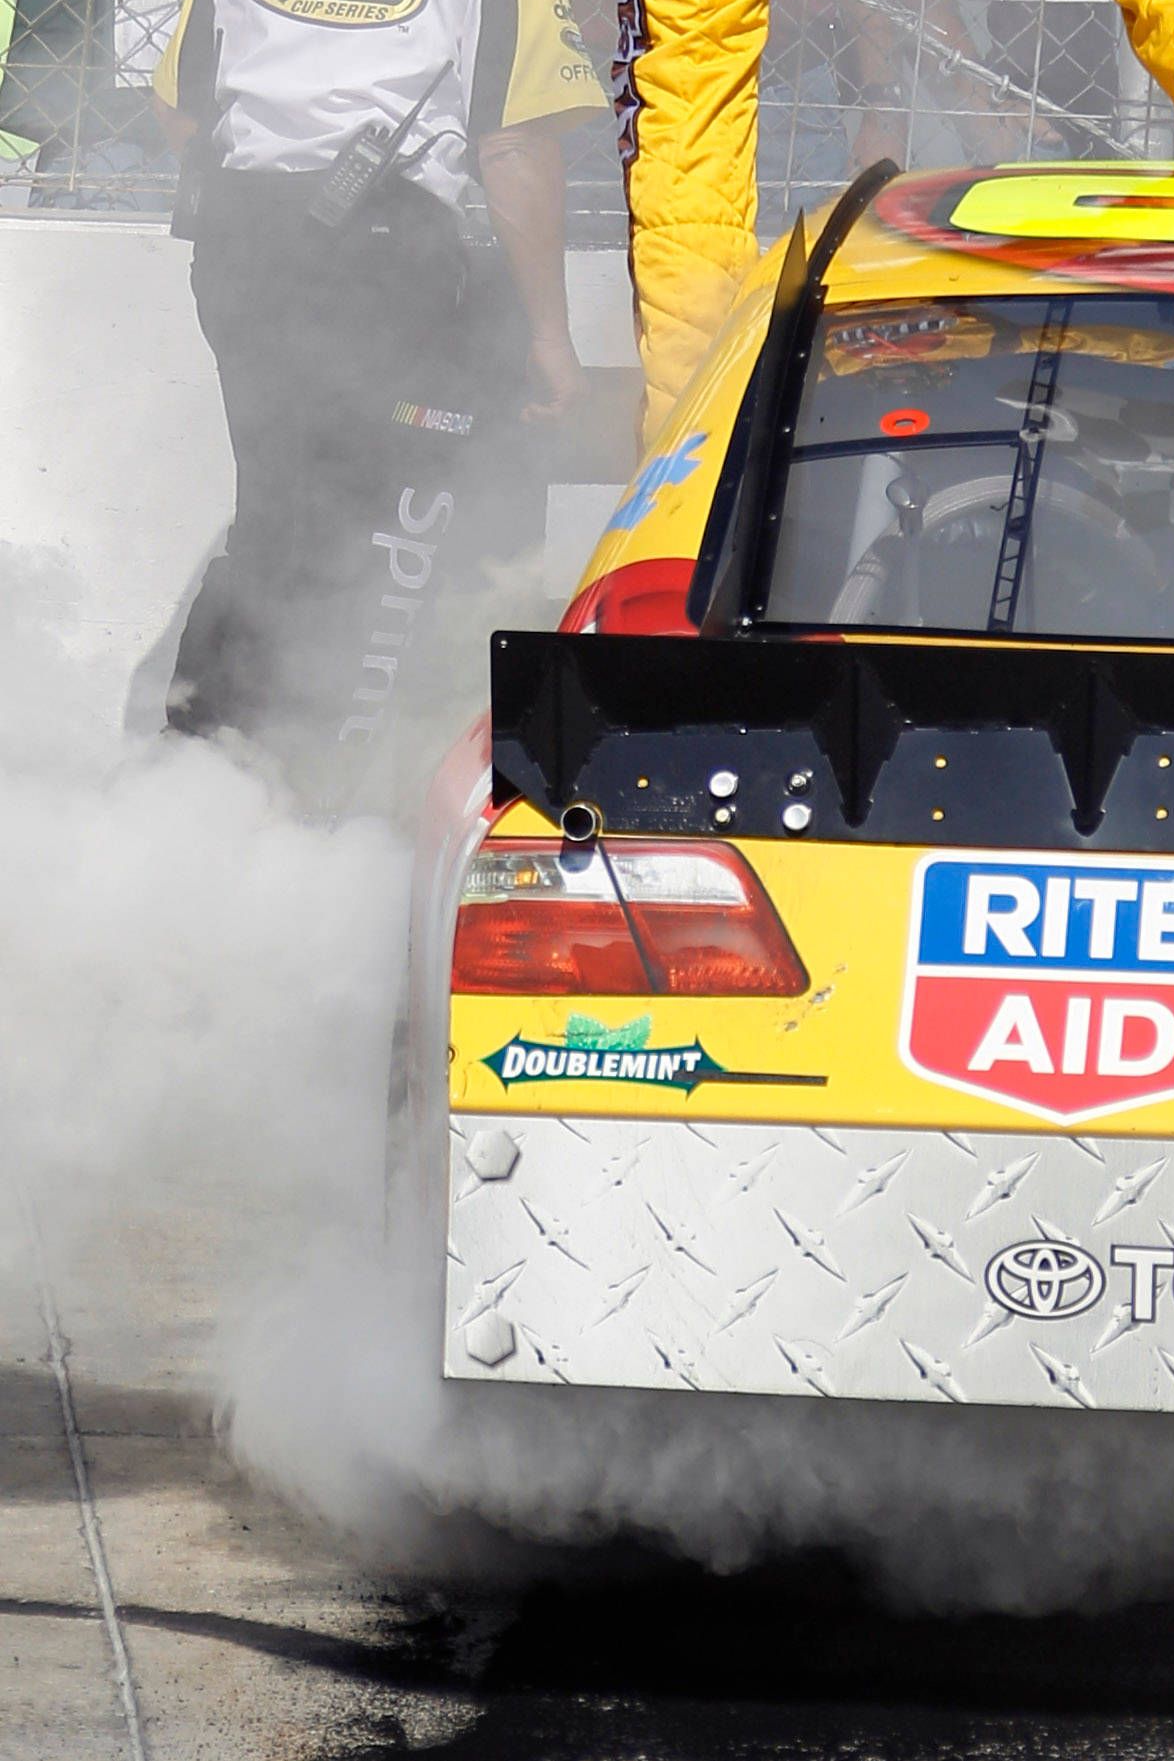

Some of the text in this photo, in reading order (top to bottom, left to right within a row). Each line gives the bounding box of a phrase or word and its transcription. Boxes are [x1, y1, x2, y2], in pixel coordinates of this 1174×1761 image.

[291, 0, 389, 21] CUP SERIES
[421, 408, 473, 436] NASCAR
[501, 1045, 702, 1081] DOUBLEMINT
